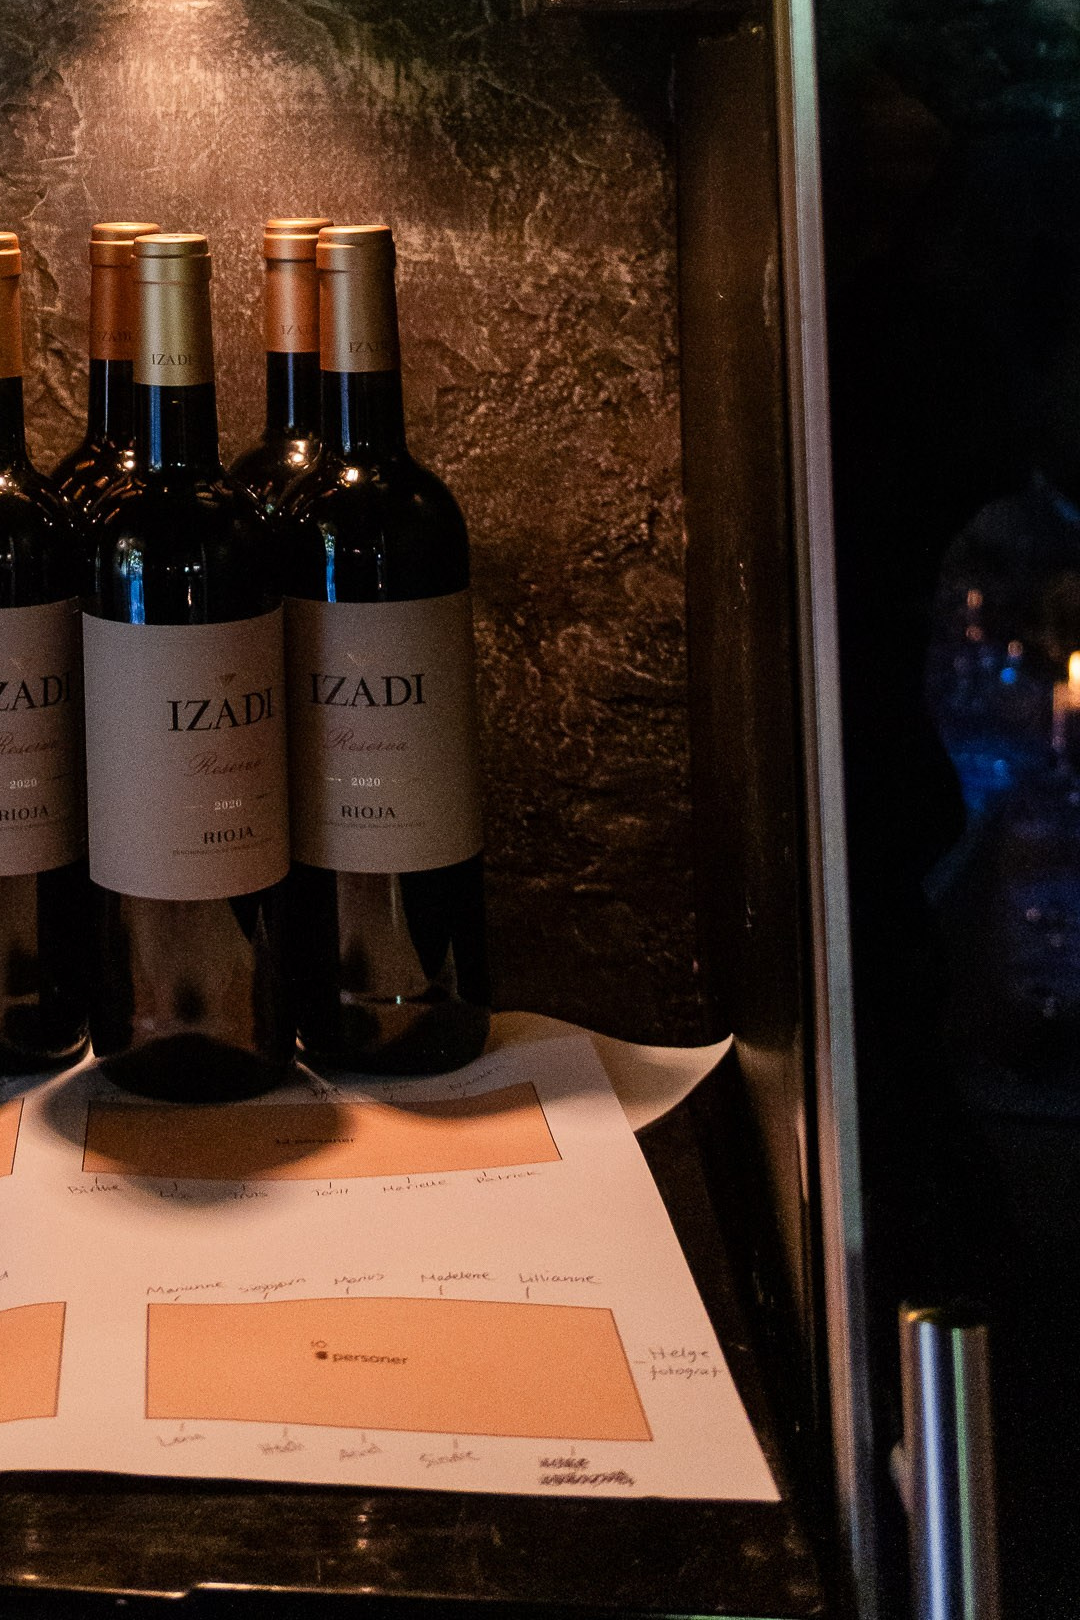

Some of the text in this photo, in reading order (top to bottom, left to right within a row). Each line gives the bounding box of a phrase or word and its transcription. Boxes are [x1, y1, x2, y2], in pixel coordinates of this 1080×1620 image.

[310, 673, 426, 707] IZADI
[167, 687, 273, 732] IZADI
[322, 730, 407, 752] Reserva
[9, 779, 38, 790] 2020
[351, 778, 381, 787] 2020
[214, 799, 242, 811] 2020
[341, 805, 396, 820] RIOJA
[203, 826, 254, 845] RIOJA
[333, 1353, 408, 1365] personer
[648, 1347, 710, 1364] Helge
